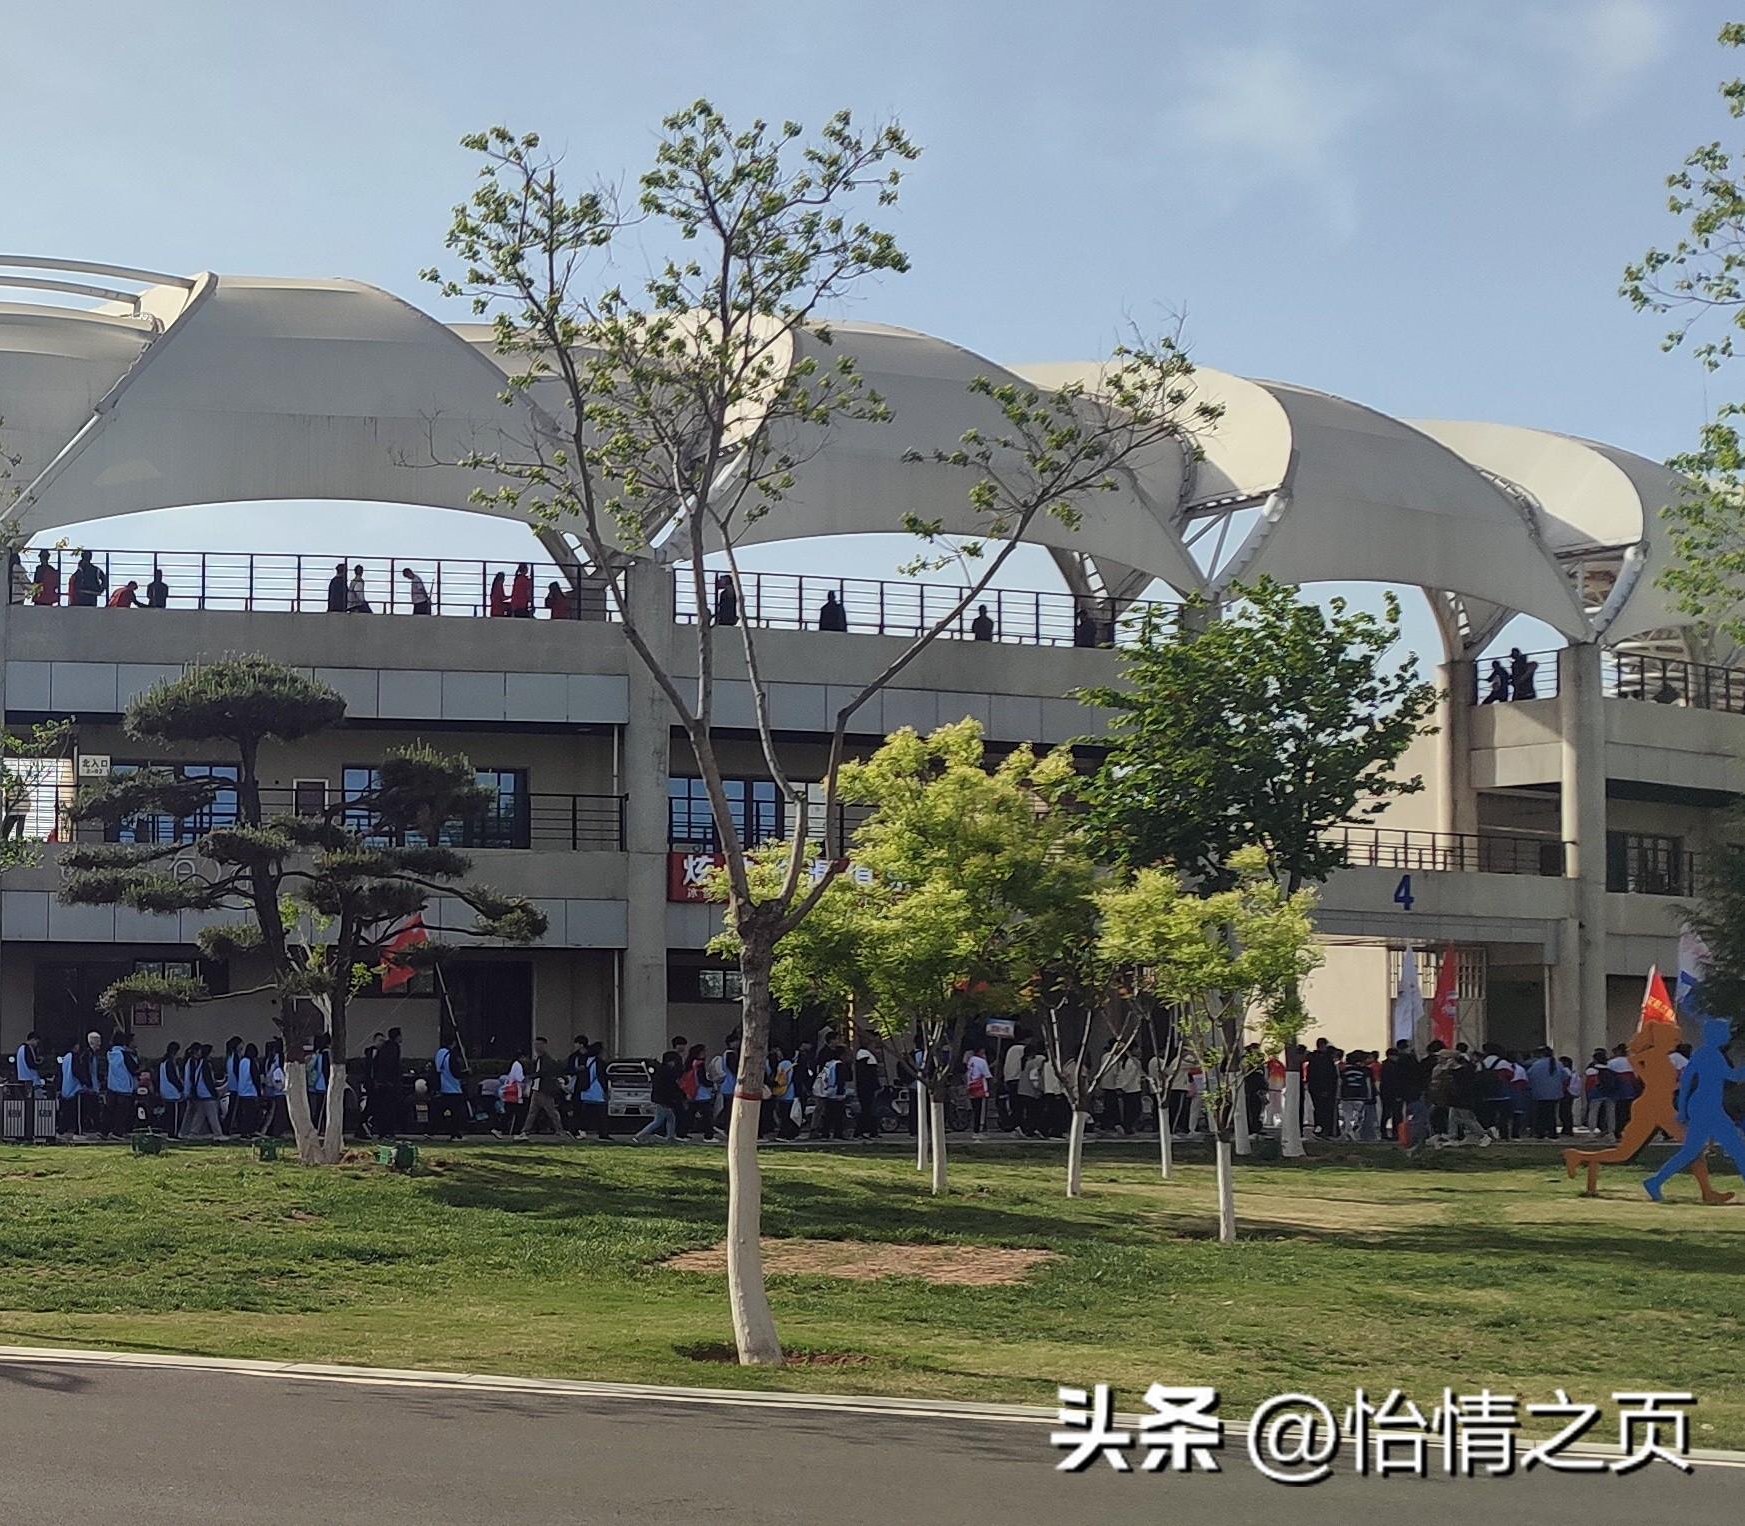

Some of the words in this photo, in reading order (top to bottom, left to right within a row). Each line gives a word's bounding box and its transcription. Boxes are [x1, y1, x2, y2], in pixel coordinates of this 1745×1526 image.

[82, 759, 108, 768] 北入口
[1394, 875, 1415, 911] 4
